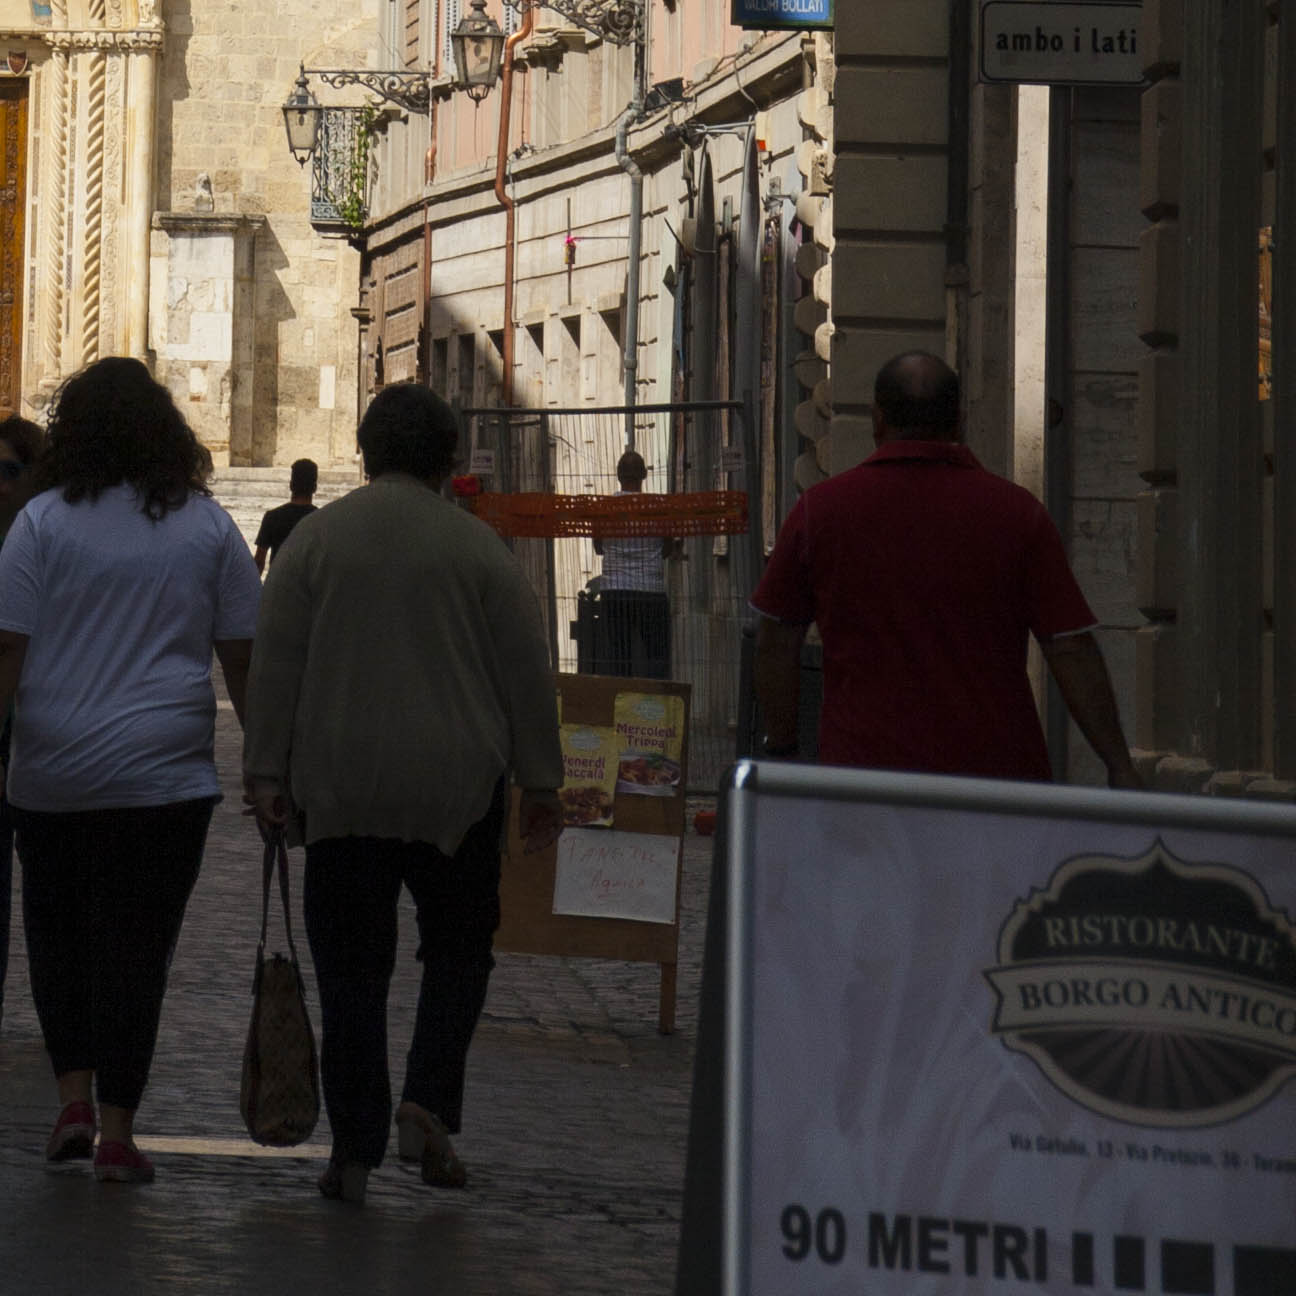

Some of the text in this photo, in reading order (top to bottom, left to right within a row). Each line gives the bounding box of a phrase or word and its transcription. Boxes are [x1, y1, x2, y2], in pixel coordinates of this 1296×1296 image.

[996, 26, 1137, 53] ambo i lati
[1044, 915, 1280, 970] RISTORANTE
[1019, 979, 1296, 1036] BORGO ANTICO
[779, 1205, 1048, 1283] 90 METRI
